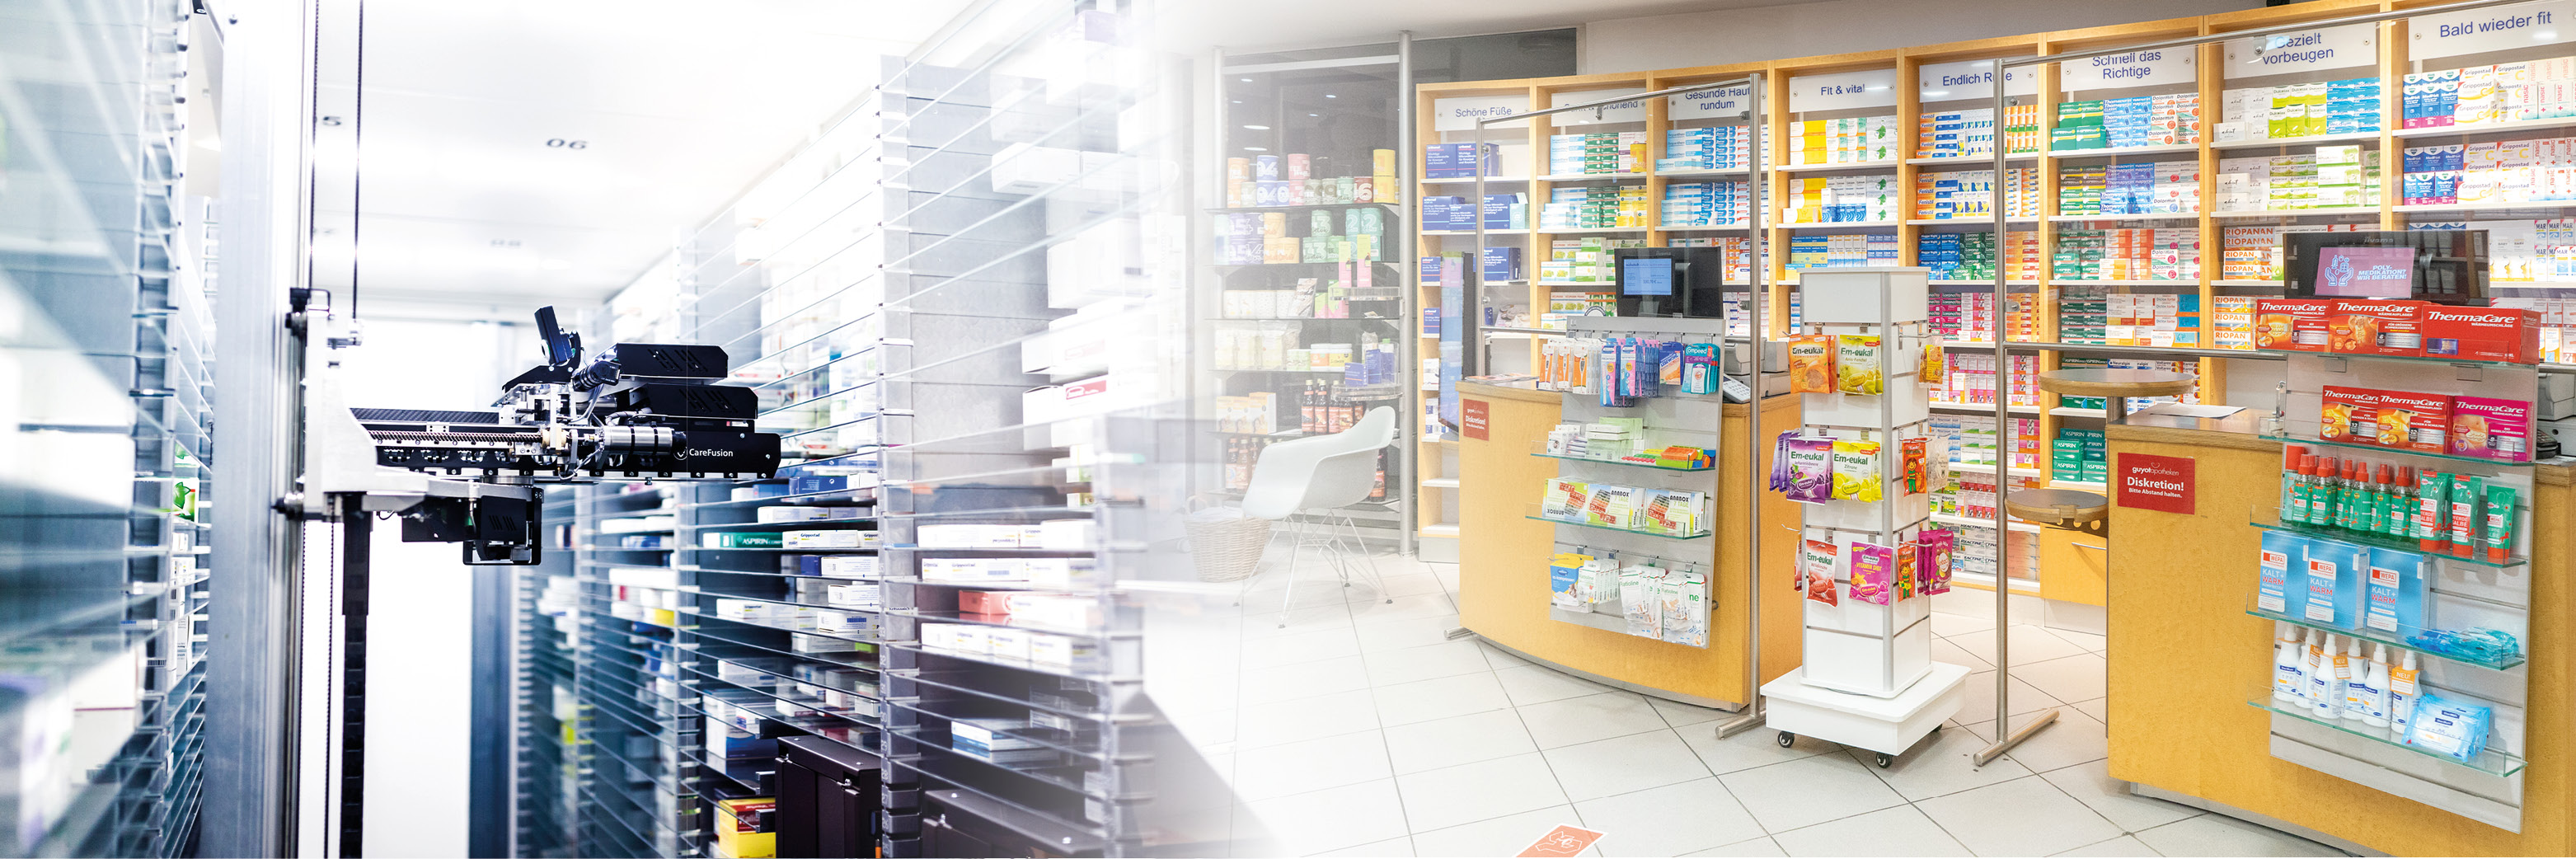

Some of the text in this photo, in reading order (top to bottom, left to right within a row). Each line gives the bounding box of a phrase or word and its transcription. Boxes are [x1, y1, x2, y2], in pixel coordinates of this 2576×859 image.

[2440, 12, 2551, 37] Bald wieder fit
[2275, 32, 2321, 49] Gezielt
[2092, 51, 2161, 67] Schnell das
[2263, 48, 2334, 65] vorbeugen
[2103, 66, 2151, 79] Richtige
[1943, 73, 2012, 86] Endlich Re
[1685, 88, 1726, 101] Gesunde
[1820, 83, 1865, 96] Fit & vital
[1700, 100, 1735, 110] rundum
[2459, 104, 2488, 112] Grippostad
[1455, 106, 1512, 118] Schöne Füße
[546, 138, 588, 150] 06
[2485, 150, 2494, 161] C
[2519, 148, 2528, 159] C
[2260, 303, 2327, 312] ThermaCare
[2337, 303, 2415, 313] ThermaCare
[2428, 311, 2515, 324] ThermaCare
[1686, 346, 1707, 354] Compeed
[1841, 347, 1874, 356] Em-eukal
[2380, 395, 2445, 407] ThermaCare
[2456, 401, 2526, 414] ThermaCare
[689, 448, 734, 458] CareFusion
[1790, 452, 1824, 461] Em-eukal
[1834, 453, 1868, 465] Em-eukal
[2127, 476, 2184, 491] Diskretion!
[1807, 552, 1833, 566] Em-eukal
[2271, 555, 2284, 564] WEPA
[2319, 564, 2332, 573] WEPA
[2262, 575, 2284, 586] WARM
[2381, 572, 2395, 580] WEPA
[2310, 585, 2333, 596] WARM
[2371, 594, 2395, 605] WARM
